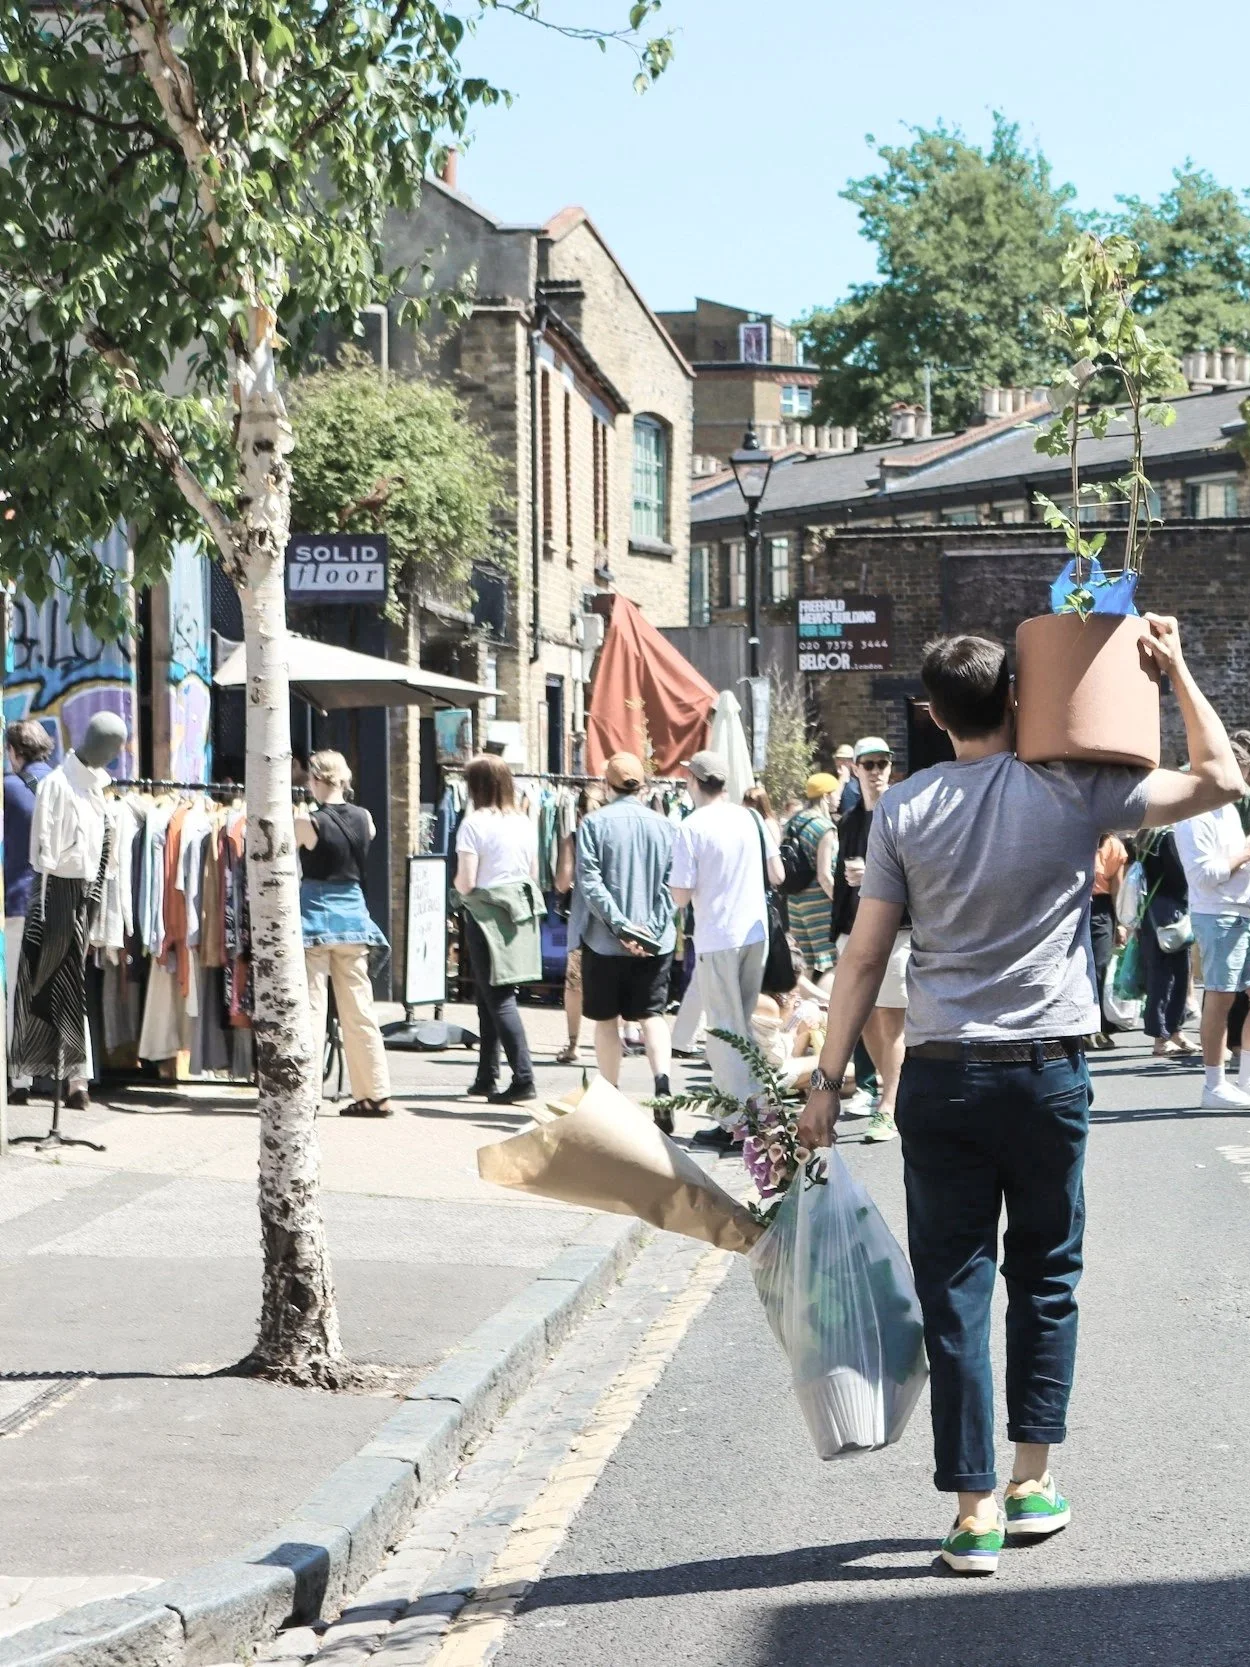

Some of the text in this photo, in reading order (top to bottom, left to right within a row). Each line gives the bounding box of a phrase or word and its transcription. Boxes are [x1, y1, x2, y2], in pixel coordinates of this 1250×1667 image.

[295, 546, 379, 562] SOLID
[297, 564, 378, 588] floor
[798, 599, 846, 612] FREEHOLD
[831, 610, 877, 624] BUILDING
[818, 623, 843, 636] SALE
[799, 639, 889, 651] 020 7375 3444
